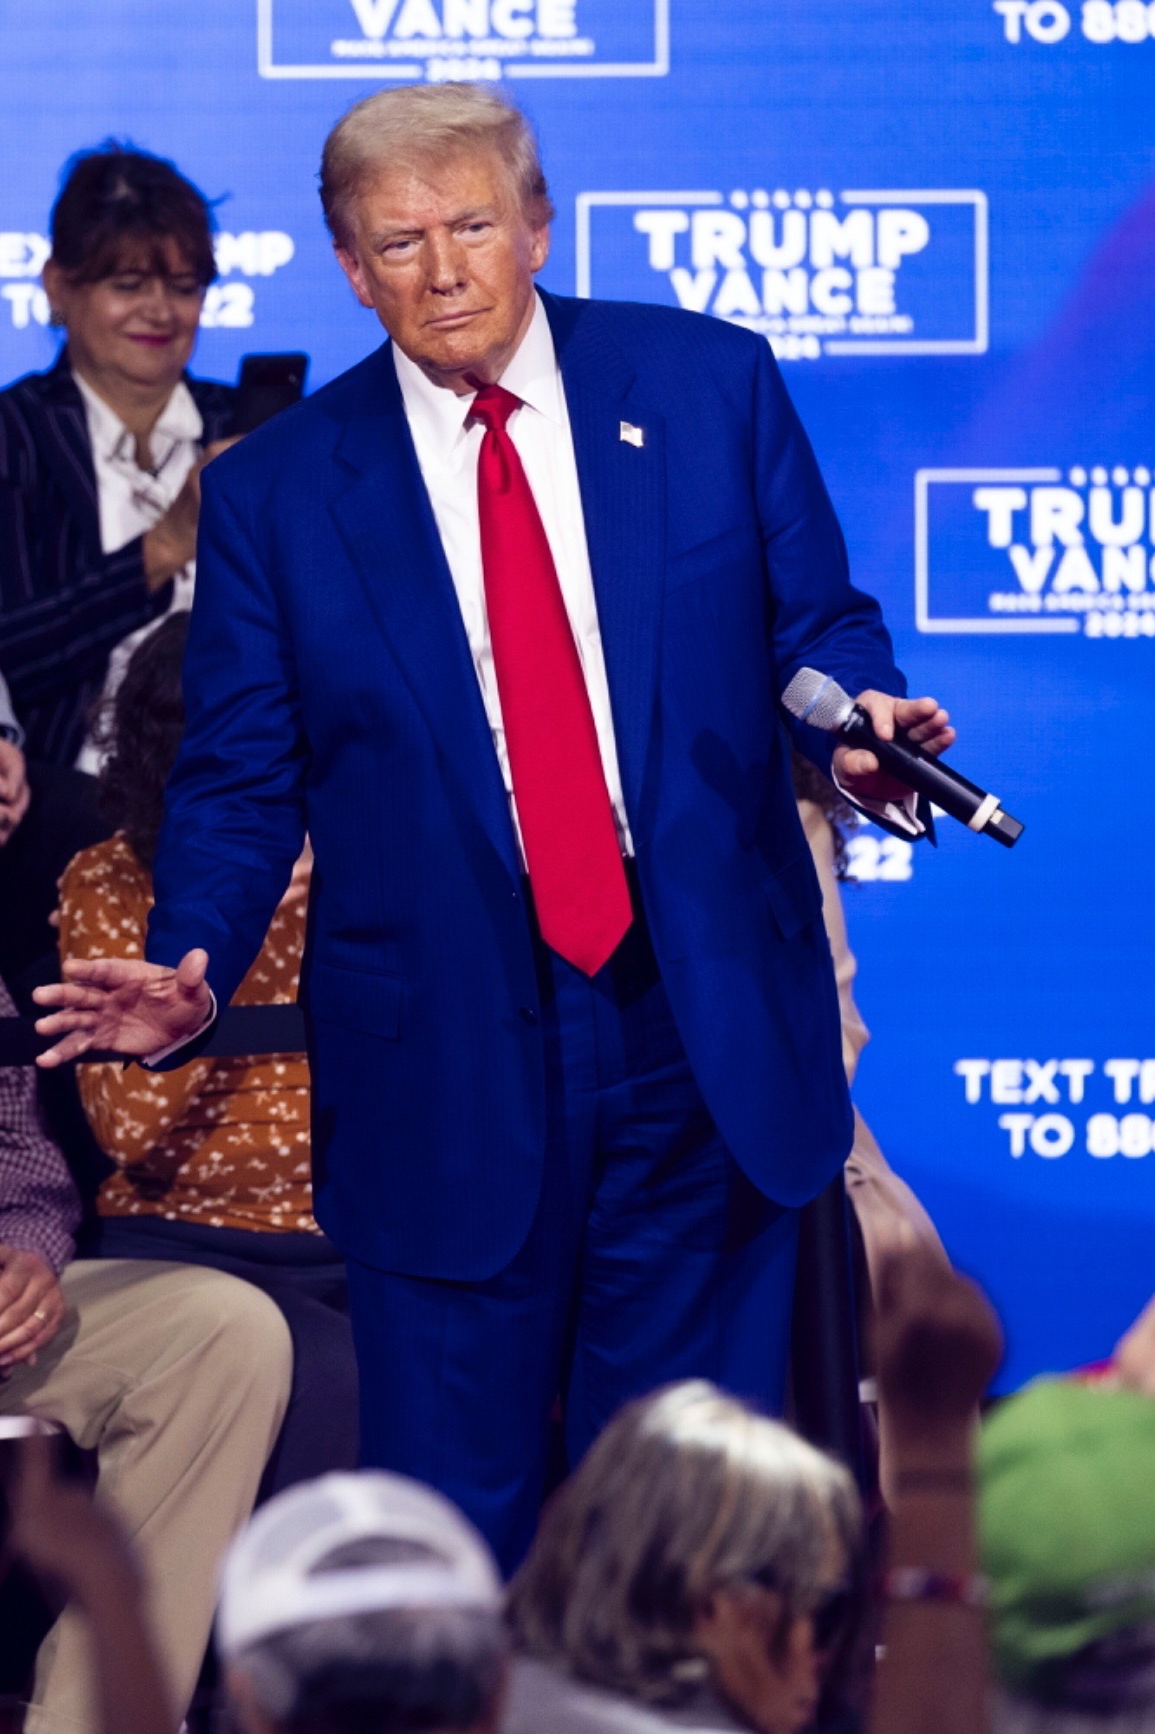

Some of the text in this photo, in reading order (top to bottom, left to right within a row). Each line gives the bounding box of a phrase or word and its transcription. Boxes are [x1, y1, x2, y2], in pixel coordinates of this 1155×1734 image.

[350, 0, 577, 38] VANCE
[994, 0, 1155, 43] TO 88
[634, 208, 929, 269] TRUMP
[670, 268, 896, 315] VANCE
[974, 486, 1155, 548] TRU
[1009, 544, 1155, 593] VAN
[956, 1059, 1094, 1104] TEXT
[999, 1113, 1155, 1158] TO 88
